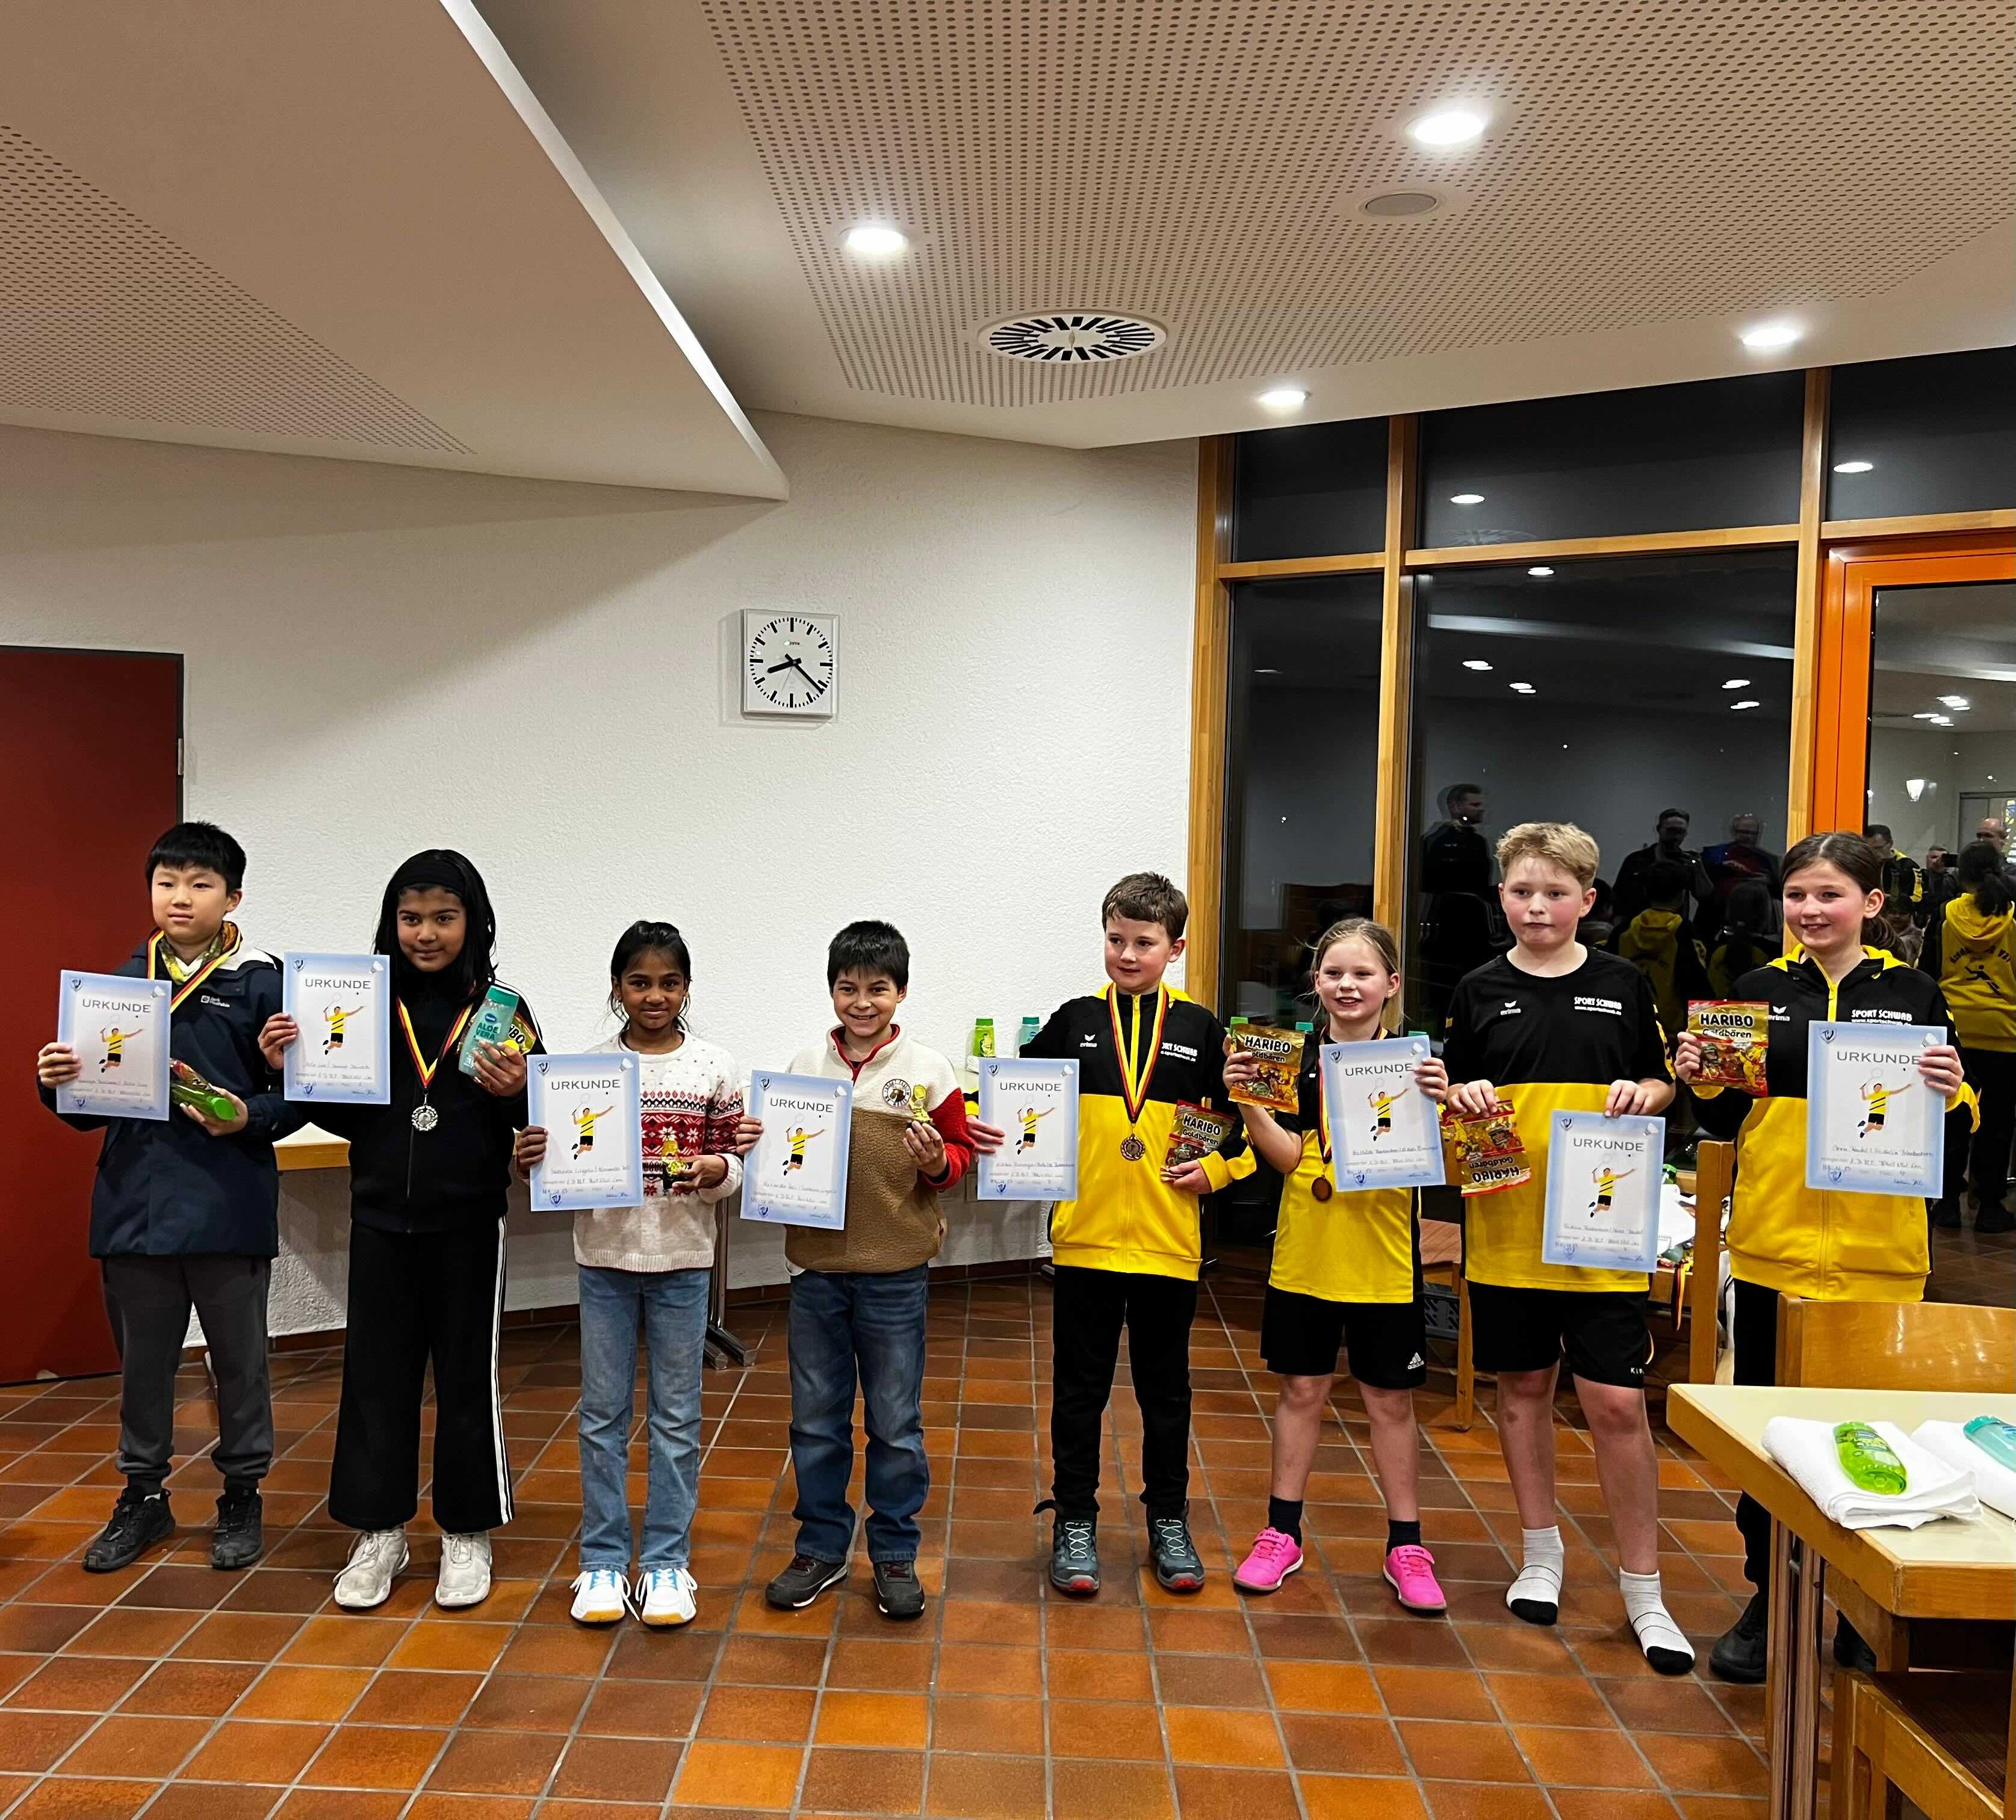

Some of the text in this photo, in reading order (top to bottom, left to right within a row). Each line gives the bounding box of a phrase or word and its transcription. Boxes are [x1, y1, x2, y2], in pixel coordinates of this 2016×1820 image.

[305, 979, 371, 989] URKUNDE
[82, 999, 151, 1013] URKUNDE
[1574, 997, 1622, 1010] SPORT SCHWAB
[1701, 1014, 1753, 1027] HARIBO
[1851, 1009, 1912, 1022] SPORT SCHWAB
[476, 1029, 495, 1040] VERA
[478, 1023, 499, 1033] ALOE
[1173, 1044, 1198, 1057] SCHWAB
[1245, 1036, 1291, 1053] HARIBO
[1247, 1050, 1285, 1062] oldbären
[1837, 1051, 1921, 1065] URKUNDE
[1345, 1063, 1413, 1076] URKUNDE
[551, 1079, 621, 1090] URKUNDE
[999, 1082, 1062, 1092] URKUNDE
[770, 1097, 834, 1113] URKUNDE
[1183, 1115, 1221, 1136] HARIBO
[1573, 1138, 1644, 1152] URKUNDE
[1472, 1166, 1519, 1183] HARIBO
